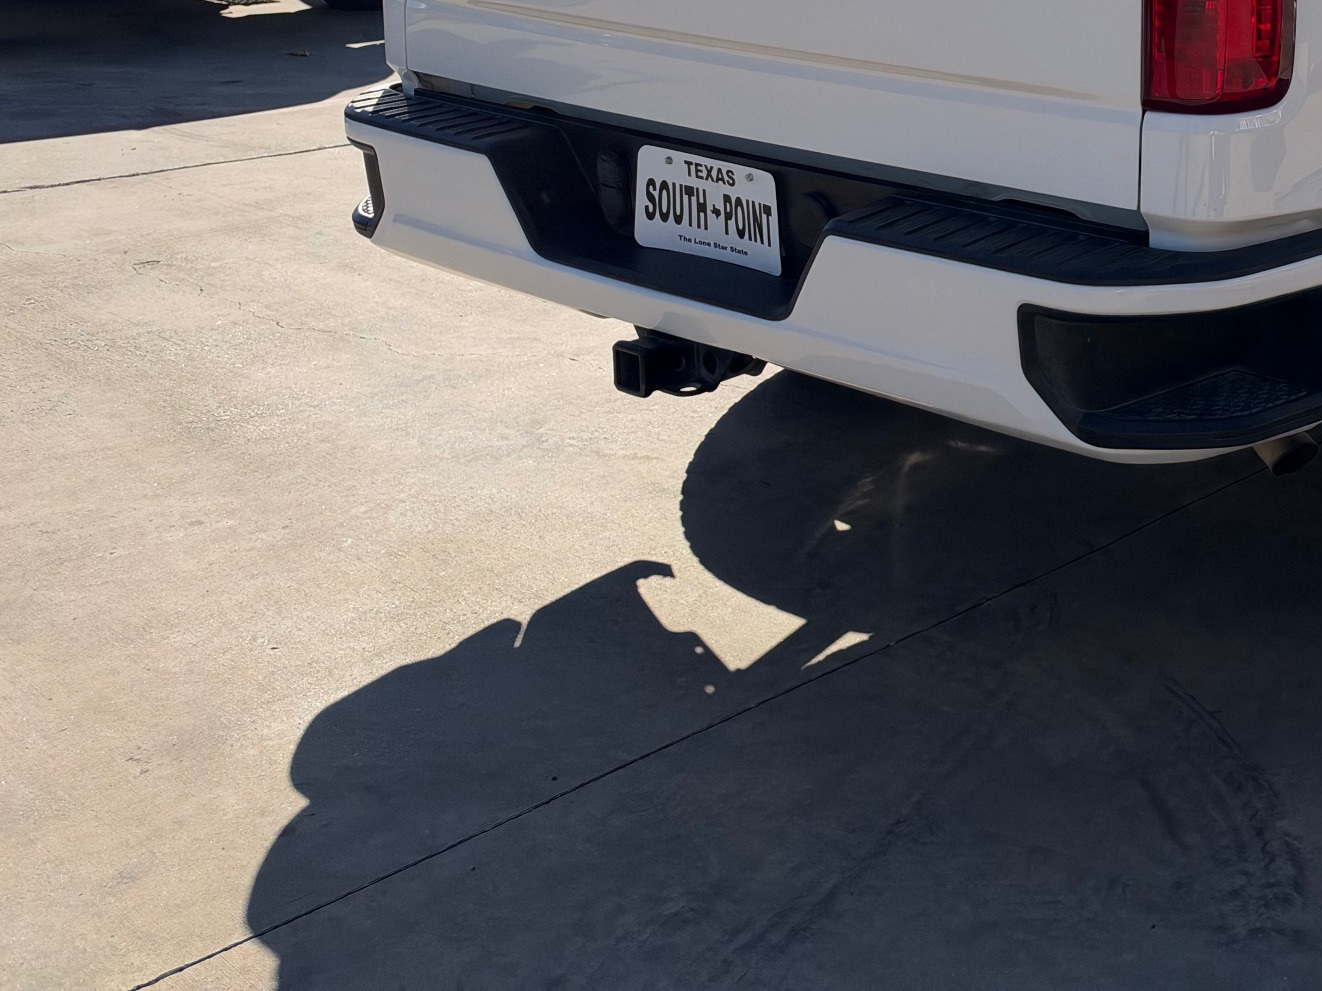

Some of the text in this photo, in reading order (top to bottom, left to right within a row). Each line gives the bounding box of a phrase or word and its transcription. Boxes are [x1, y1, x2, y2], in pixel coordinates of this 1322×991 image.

[684, 160, 736, 187] TEXAS
[644, 178, 772, 247] SOUTH POINT
[678, 234, 748, 256] The Lone Star State
